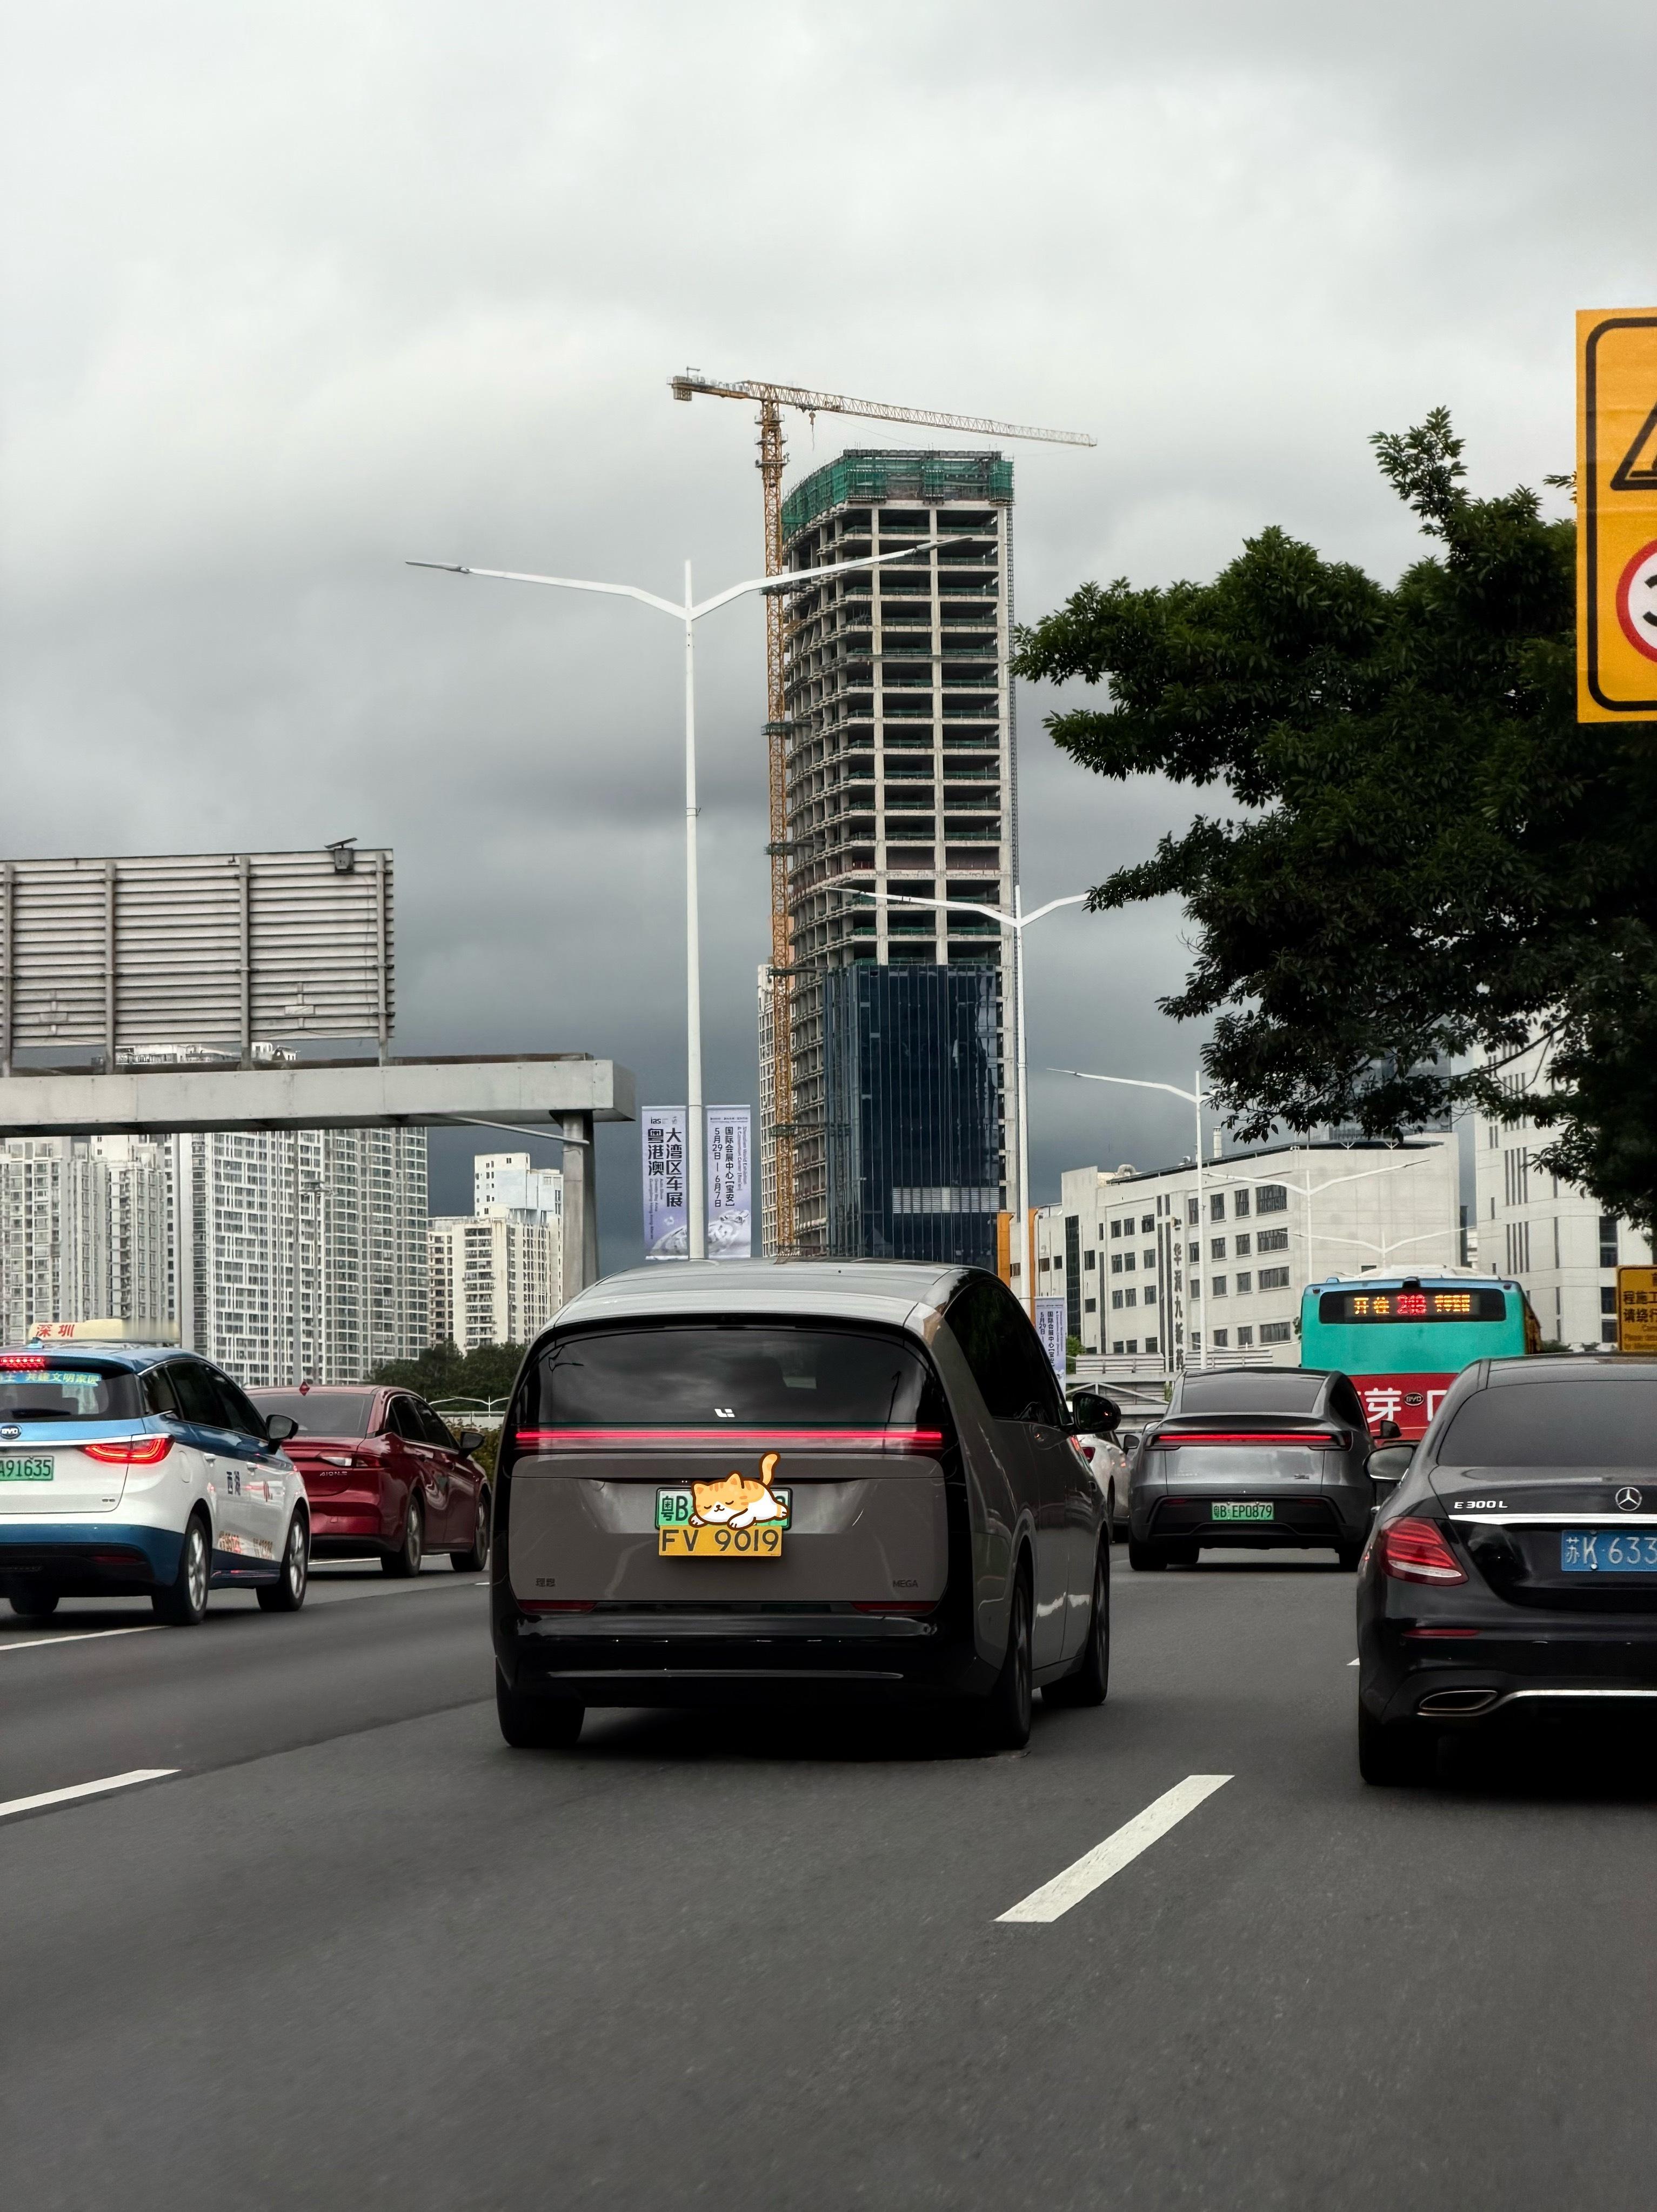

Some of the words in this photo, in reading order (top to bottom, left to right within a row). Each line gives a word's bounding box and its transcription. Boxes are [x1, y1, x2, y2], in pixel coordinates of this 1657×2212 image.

[647, 1128, 664, 1176] 粤港澳
[666, 1127, 683, 1207] 大湾区车展
[36, 1324, 75, 1337] 深圳
[662, 1529, 699, 1551] FV
[714, 1529, 779, 1551] 9019
[892, 1580, 919, 1588] MEGA
